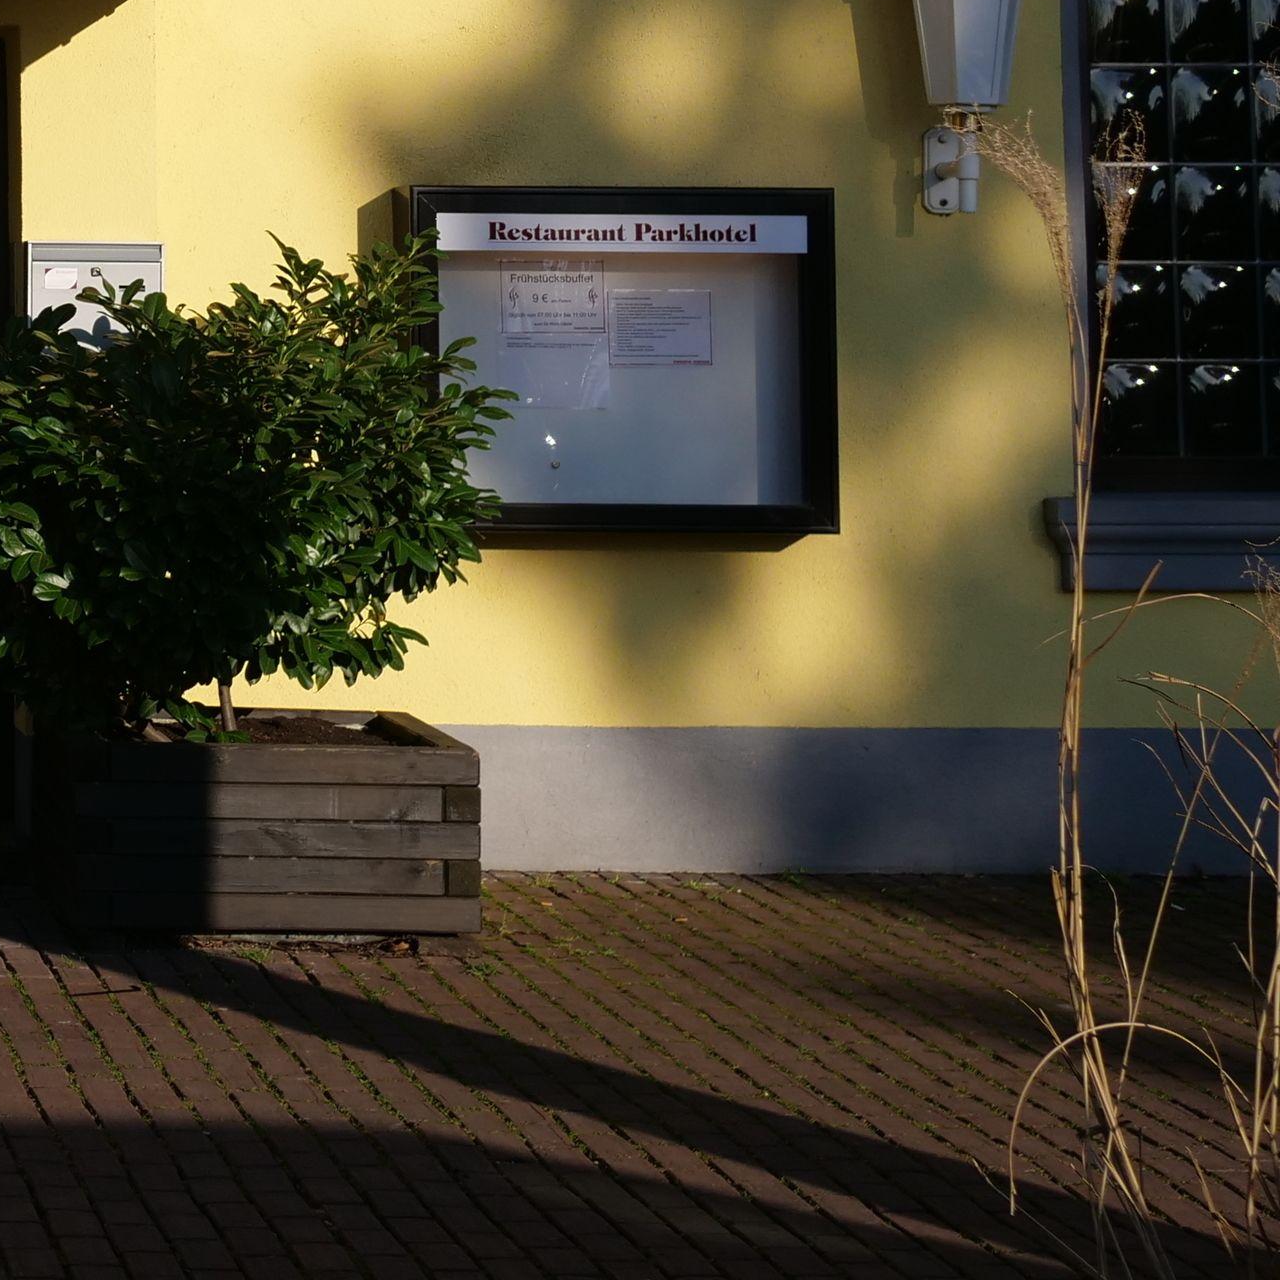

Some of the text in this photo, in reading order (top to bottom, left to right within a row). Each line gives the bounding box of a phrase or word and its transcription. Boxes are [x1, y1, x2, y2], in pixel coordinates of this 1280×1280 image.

[488, 220, 758, 243] Restaurant Parkhotel
[510, 273, 594, 284] Frühstücksbuffet
[531, 293, 539, 303] 9
